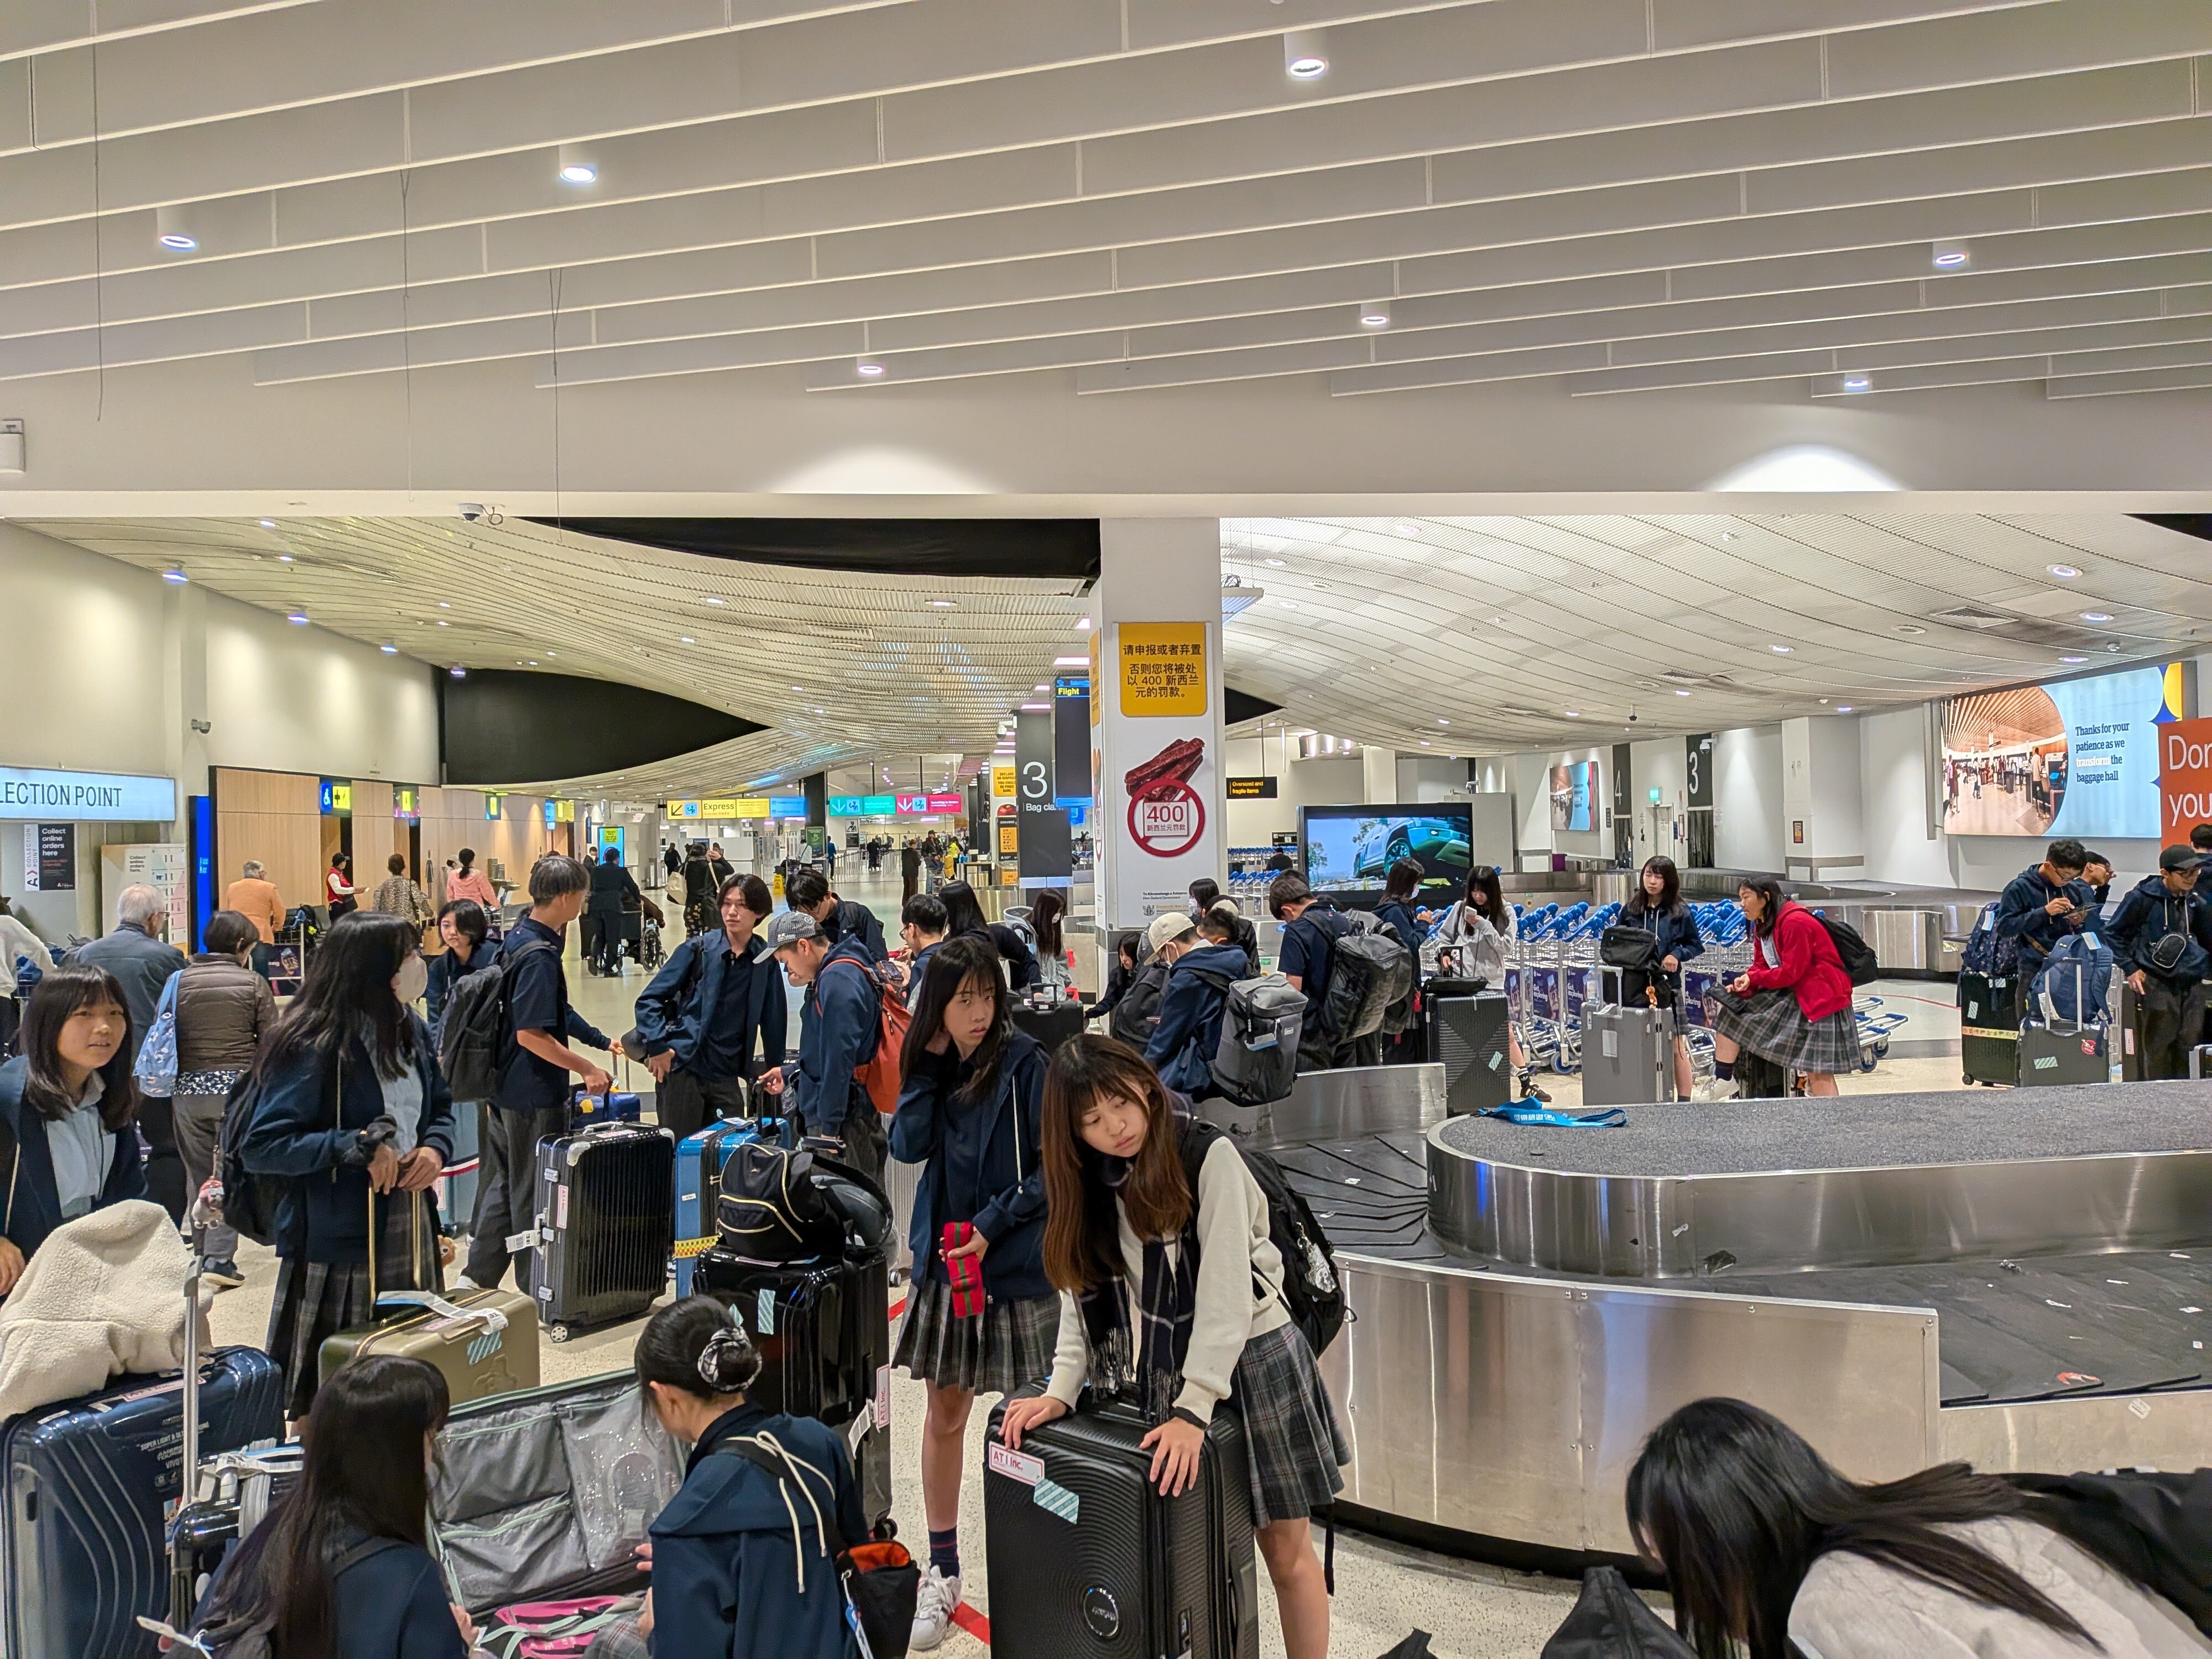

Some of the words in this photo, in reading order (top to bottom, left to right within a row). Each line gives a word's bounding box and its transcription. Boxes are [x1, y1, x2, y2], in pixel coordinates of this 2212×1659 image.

[1123, 644, 1202, 656] 请申报或者弃置
[1129, 663, 1197, 675] 否则您将被处
[1127, 675, 1138, 686] 以
[1141, 676, 1162, 685] 400
[1166, 675, 1199, 686] 新西兰
[1058, 687, 1080, 696] Flight
[1135, 686, 1185, 698] 元的罚款。
[2075, 724, 2101, 737] Thanks
[2101, 723, 2112, 734] for
[2112, 722, 2130, 734] your
[2075, 740, 2105, 754] patience
[2105, 741, 2114, 749] as
[2114, 739, 2125, 748] we
[2076, 755, 2110, 768] transform
[2111, 754, 2123, 765] the
[1022, 761, 1048, 798] 3
[1688, 751, 1698, 795] 3
[2076, 773, 2104, 784] baggage
[2105, 770, 2119, 781] hall
[1615, 770, 1623, 805] 4
[75, 785, 122, 807] POINT
[703, 803, 734, 812] Express
[1026, 803, 1042, 813] Bag
[1044, 802, 1063, 811] cla
[1146, 805, 1184, 823] 400
[880, 1410, 885, 1421] AT
[993, 1451, 1004, 1463] AT
